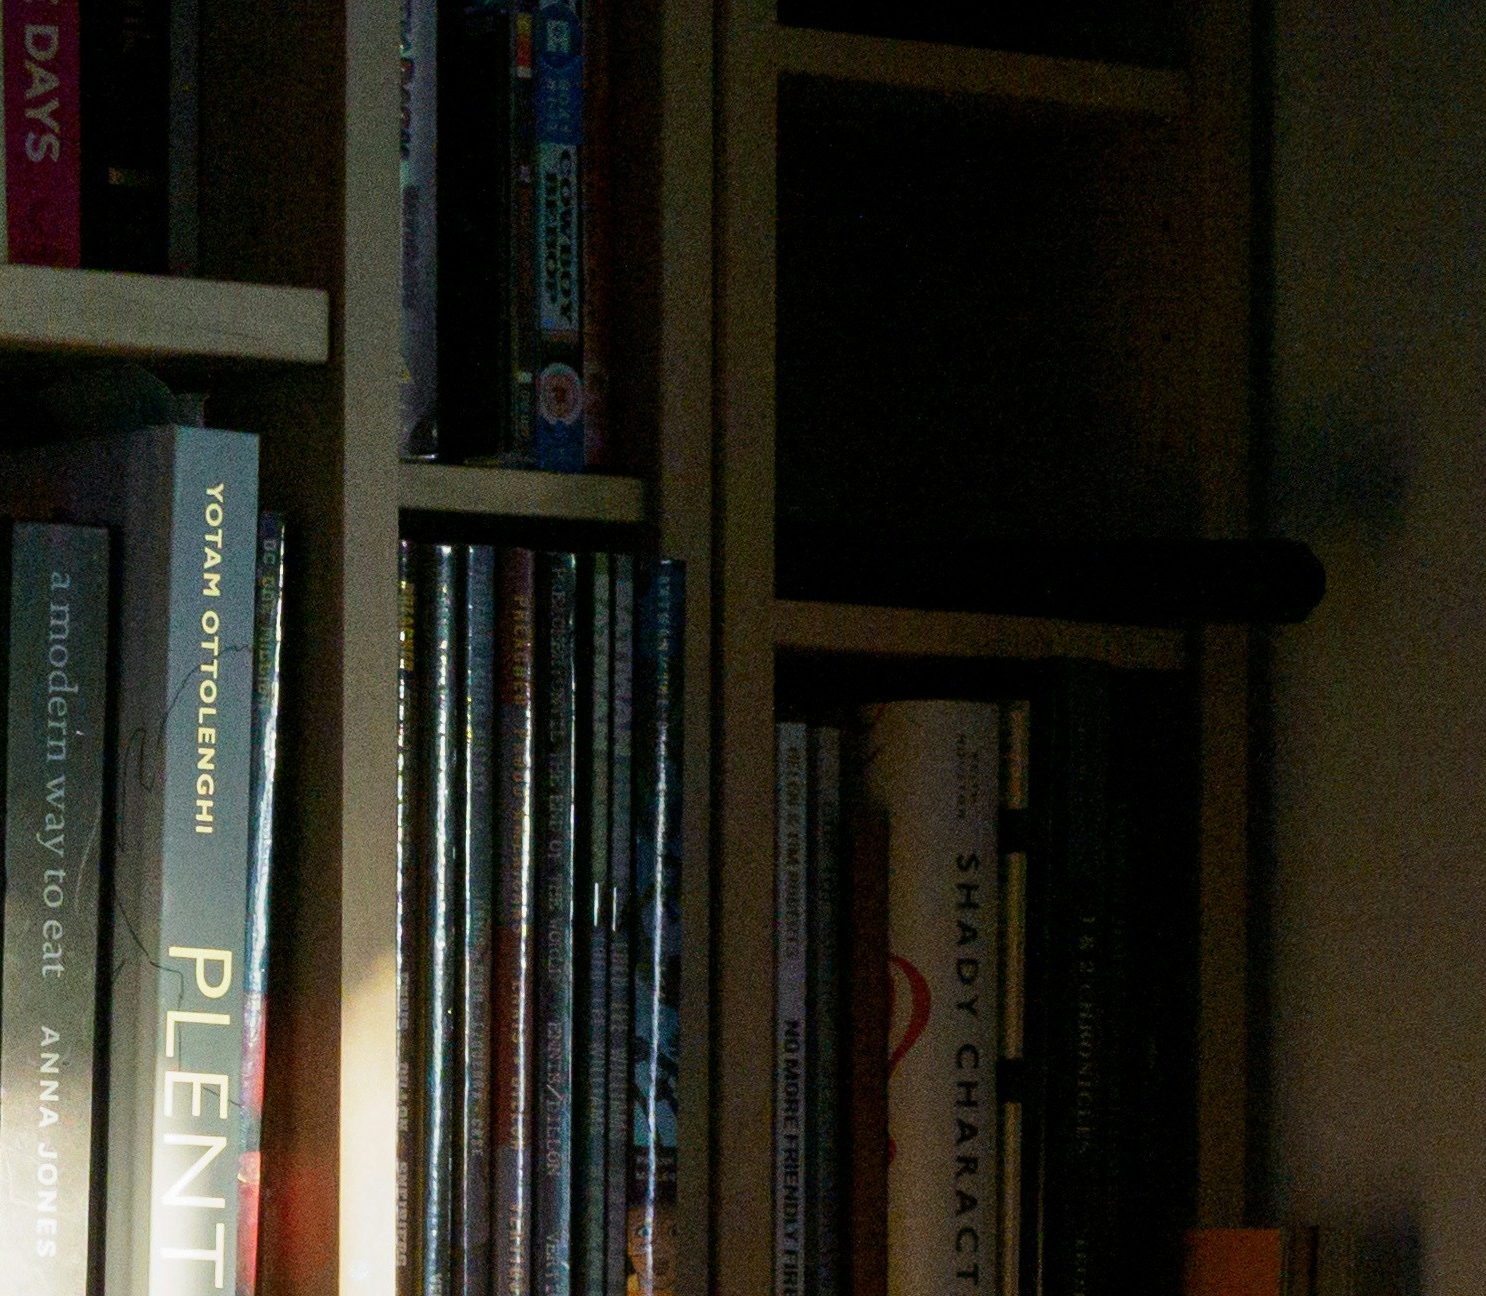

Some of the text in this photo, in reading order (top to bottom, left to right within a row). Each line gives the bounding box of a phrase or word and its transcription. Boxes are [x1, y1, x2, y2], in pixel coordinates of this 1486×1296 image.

[24, 24, 62, 164] DAYS
[559, 149, 573, 325] COWBOY
[200, 483, 226, 601] YOTAM
[192, 609, 222, 835] OTTOLENGHI
[35, 571, 82, 1259] a modern way to eat ANNA JONES
[955, 852, 983, 1017] SHADY
